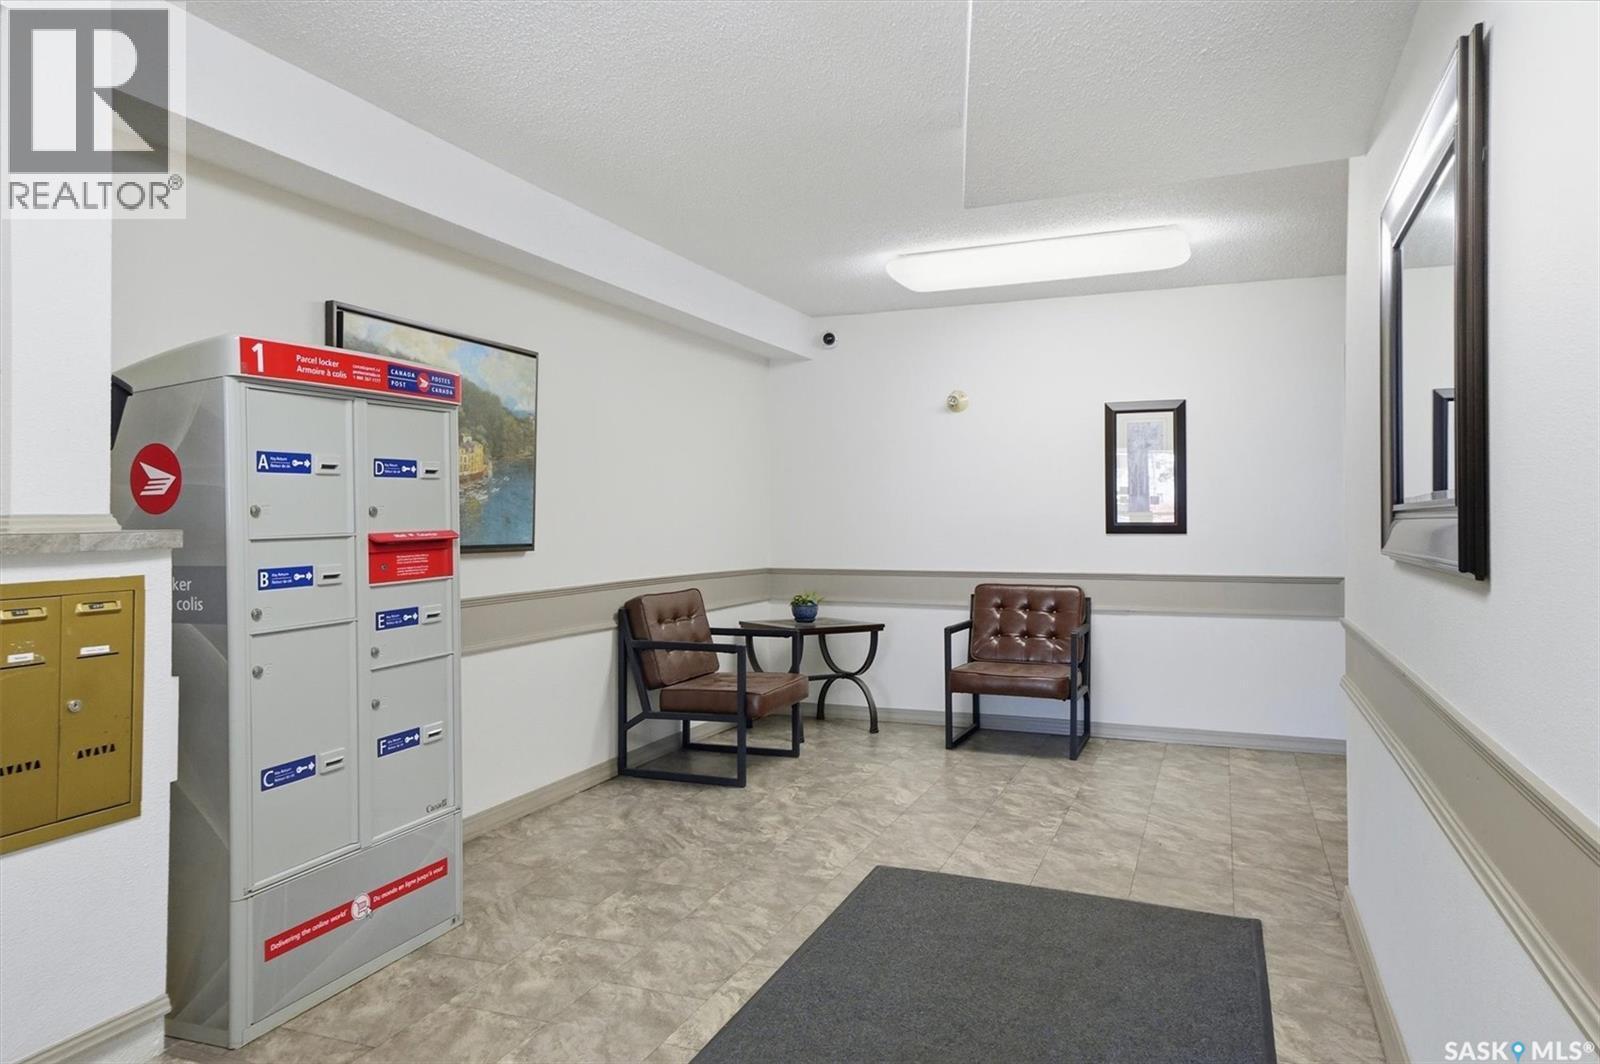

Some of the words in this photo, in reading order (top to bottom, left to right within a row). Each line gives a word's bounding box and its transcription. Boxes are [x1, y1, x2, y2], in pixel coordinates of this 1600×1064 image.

[251, 343, 265, 373] 1
[296, 354, 318, 365] Parcel
[318, 358, 340, 367] locker
[296, 365, 326, 375] Armoire
[326, 369, 331, 377] à
[332, 371, 347, 379] colis
[390, 368, 416, 378] CANADA
[390, 380, 406, 388] POST
[431, 376, 451, 385] POSTES
[431, 387, 454, 395] CANADA
[258, 454, 269, 470] A
[375, 461, 384, 475] D
[260, 572, 269, 588] B
[176, 596, 204, 611] colis
[378, 613, 385, 629] E
[380, 739, 387, 755] F
[263, 770, 274, 787] C
[373, 895, 381, 903] Du
[381, 887, 398, 899] monde
[405, 879, 417, 888] ligne
[270, 933, 301, 951] Delivering
[301, 927, 311, 936] the
[312, 919, 330, 931] online
